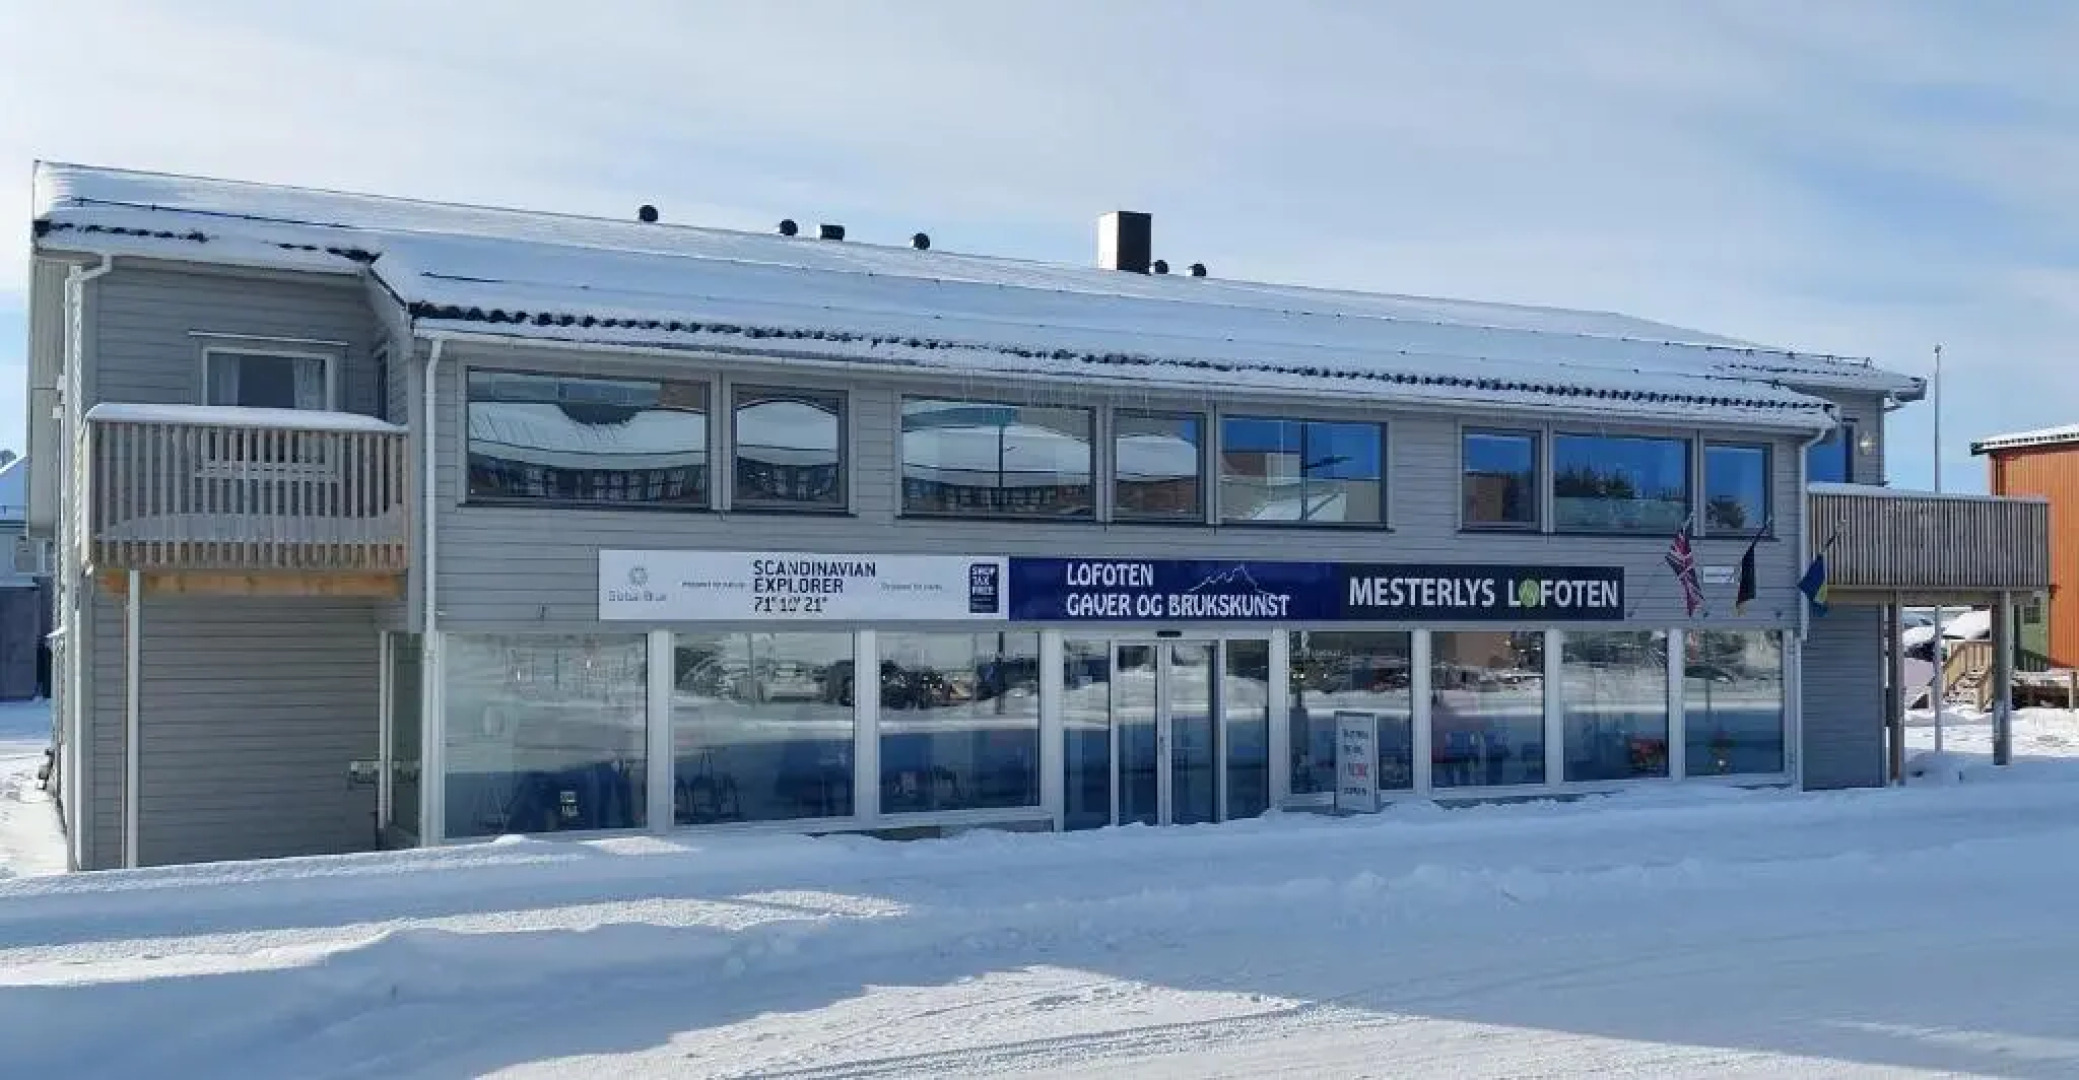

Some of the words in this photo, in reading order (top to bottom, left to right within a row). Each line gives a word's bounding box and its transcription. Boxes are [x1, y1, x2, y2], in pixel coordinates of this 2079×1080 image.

[753, 560, 876, 577] SCANDINAVIAN
[1067, 563, 1154, 586] LOFOTEN
[754, 578, 844, 594] EXPLORER
[1349, 577, 1496, 607] MESTERLYS
[1066, 593, 1132, 617] GAVER
[1136, 593, 1163, 617] OG
[1168, 594, 1291, 618] BRUKSKUNST
